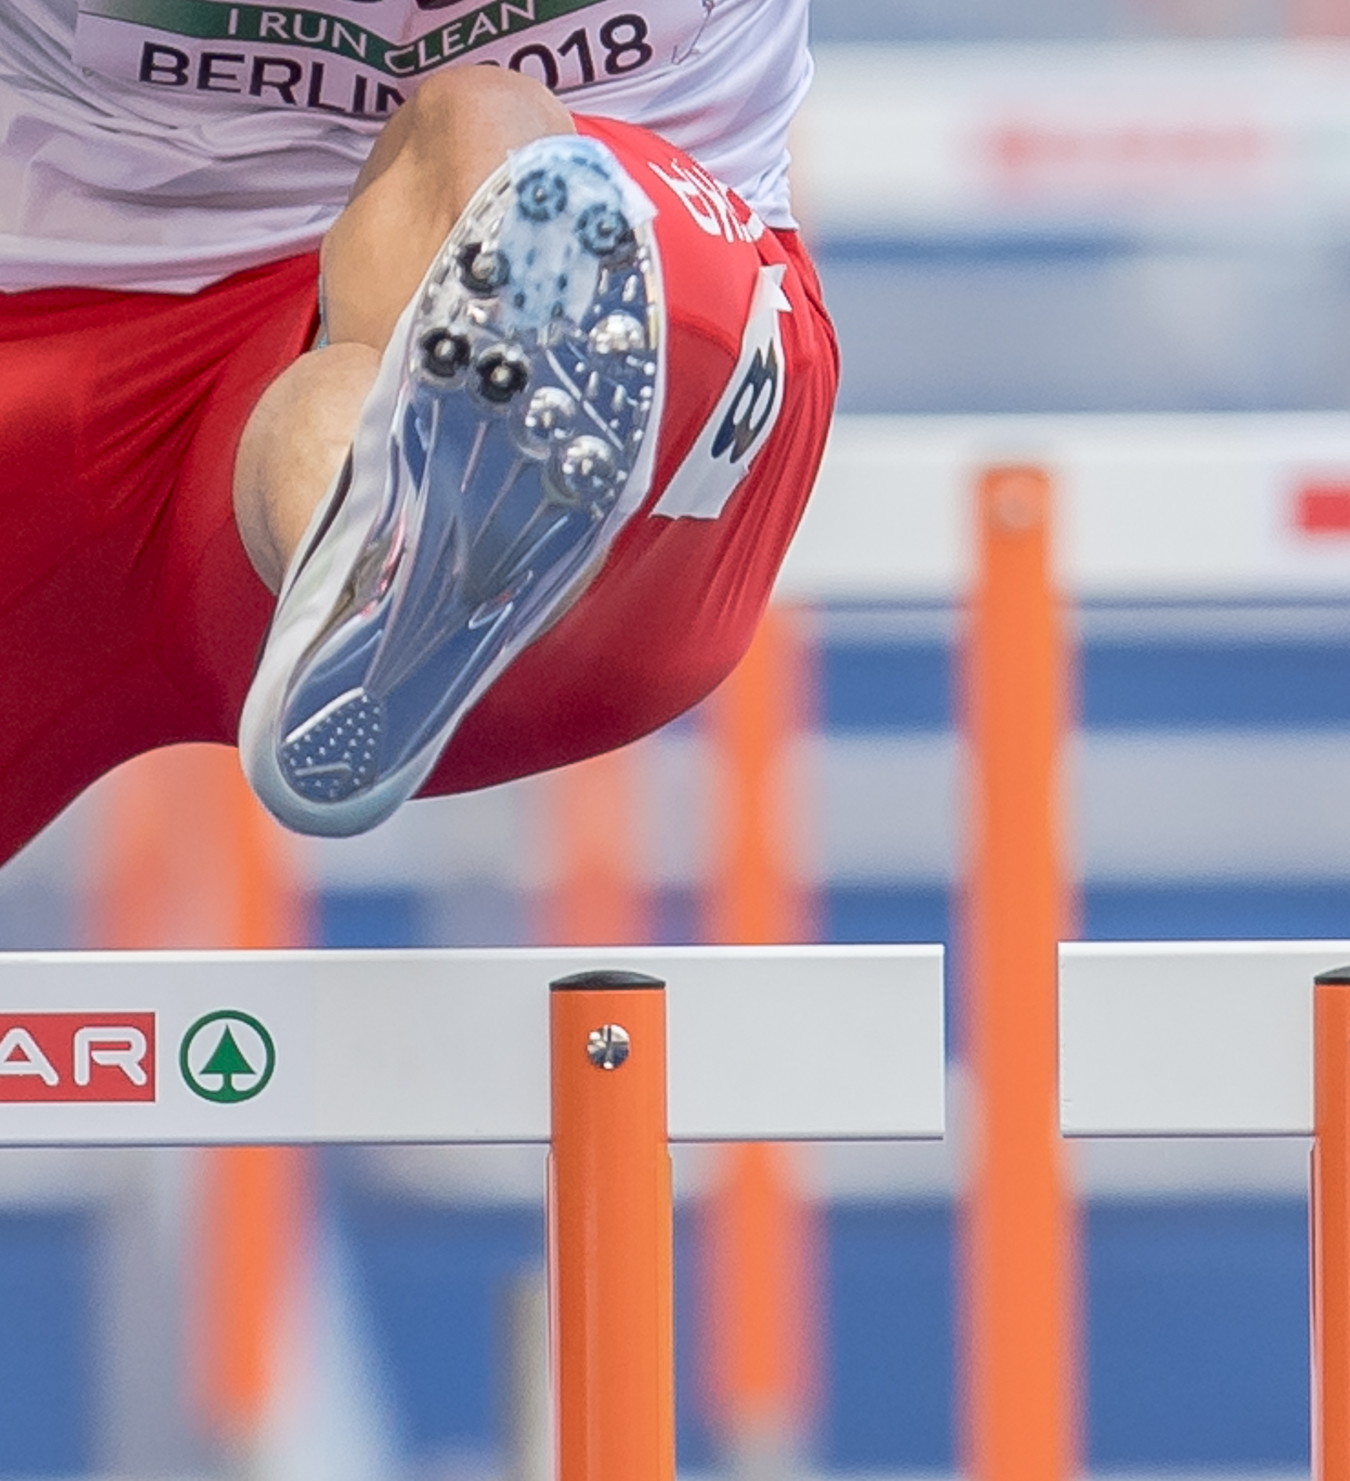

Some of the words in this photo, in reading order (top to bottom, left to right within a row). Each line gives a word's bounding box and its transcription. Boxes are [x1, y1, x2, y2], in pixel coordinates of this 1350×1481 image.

[227, 8, 238, 35] I
[259, 11, 367, 57] RUN
[476, 14, 654, 93] 018
